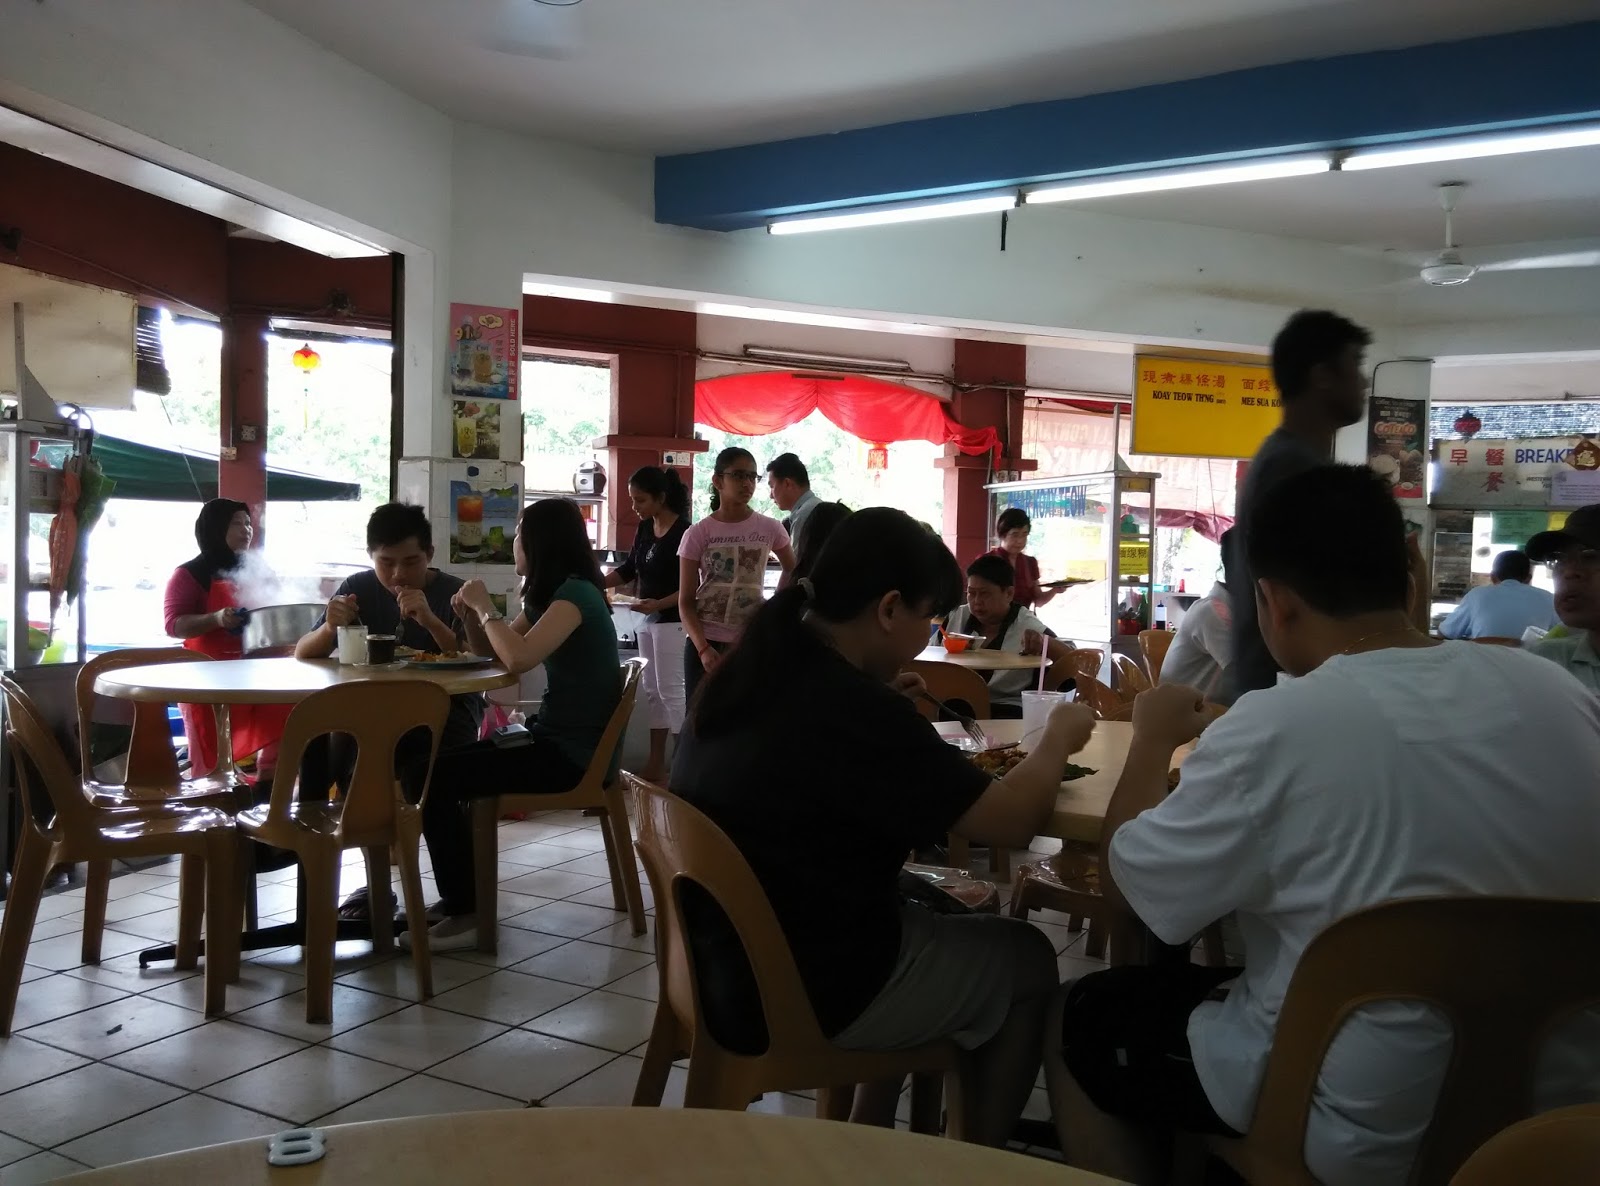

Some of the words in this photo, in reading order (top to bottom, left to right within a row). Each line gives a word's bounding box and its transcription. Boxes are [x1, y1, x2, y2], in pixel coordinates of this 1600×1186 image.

[1152, 390, 1171, 400] KOAY
[1173, 391, 1193, 401] TEOW
[1241, 397, 1256, 406] MEE
[1256, 398, 1269, 407] SUA
[1271, 399, 1281, 407] KO
[1515, 448, 1577, 464] BREAKF
